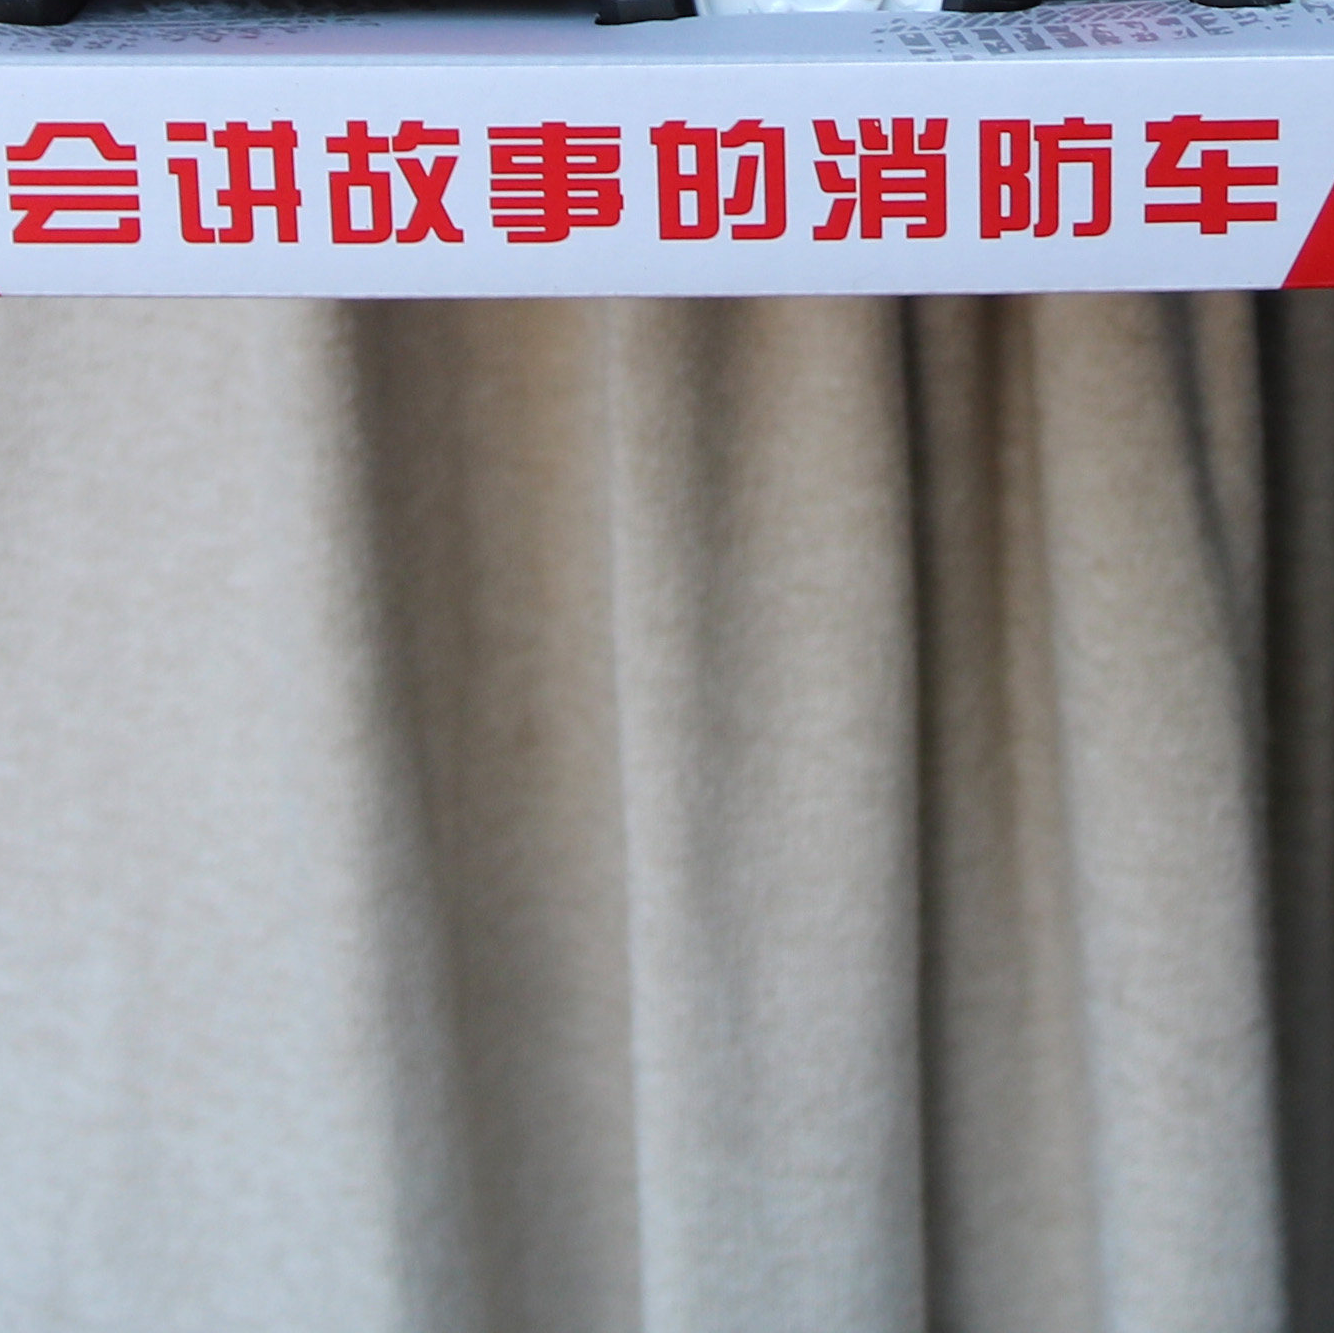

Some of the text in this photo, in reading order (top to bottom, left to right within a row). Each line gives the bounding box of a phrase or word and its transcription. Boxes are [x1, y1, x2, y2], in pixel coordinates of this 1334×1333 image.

[5, 114, 1280, 244] 会讲故事的消防车
